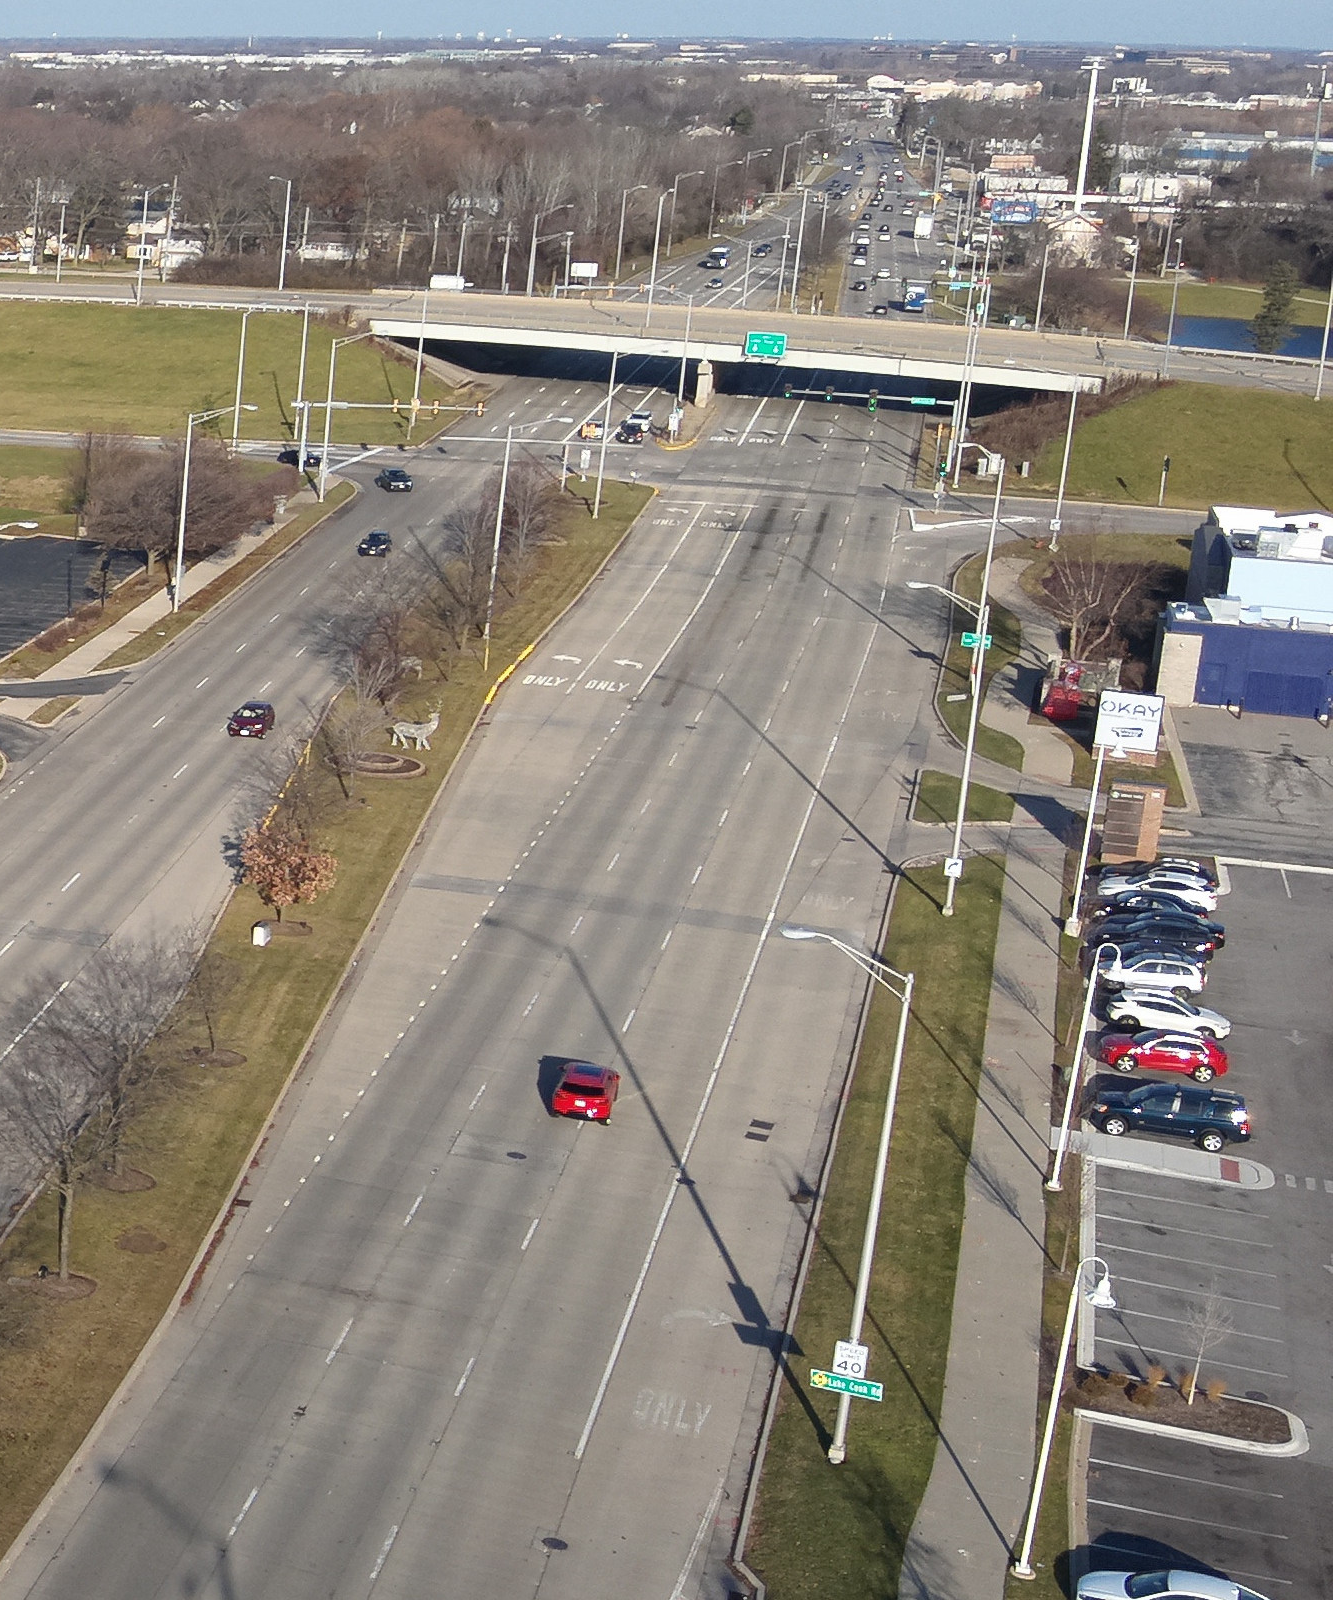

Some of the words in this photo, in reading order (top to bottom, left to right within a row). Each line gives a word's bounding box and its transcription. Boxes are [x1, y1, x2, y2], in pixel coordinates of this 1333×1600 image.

[522, 674, 569, 687] ONLY
[584, 679, 630, 692] ONLY
[1100, 700, 1160, 718] OKAY
[836, 1360, 862, 1374] 40
[828, 1377, 847, 1390] Lake
[848, 1381, 868, 1394] Cook
